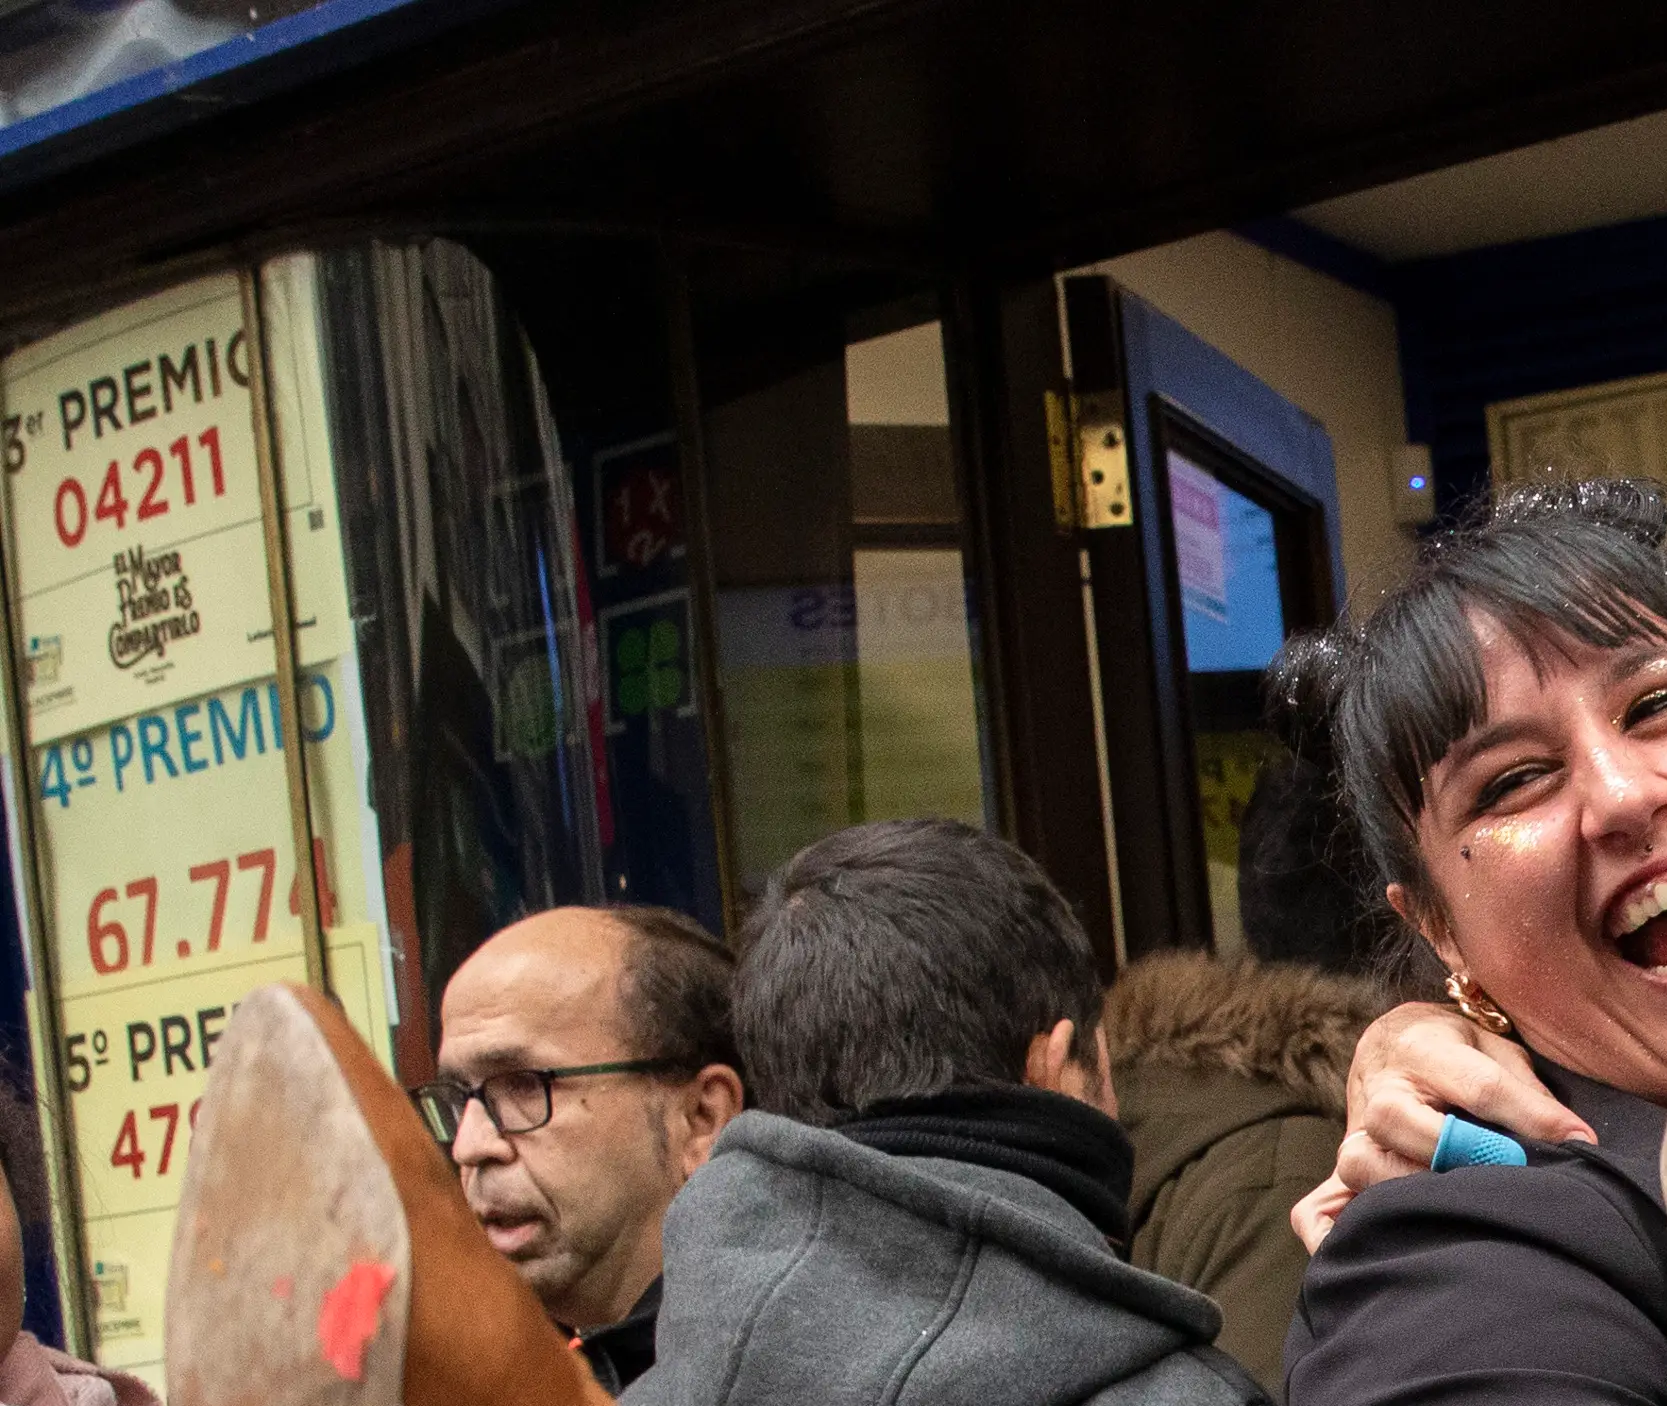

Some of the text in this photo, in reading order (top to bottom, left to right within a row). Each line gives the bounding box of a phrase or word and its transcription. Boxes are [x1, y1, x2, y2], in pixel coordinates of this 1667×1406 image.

[55, 424, 226, 549] 04211
[109, 674, 336, 792] PREMIO
[126, 1003, 241, 1082] PRE
[111, 1098, 203, 1180] 47
